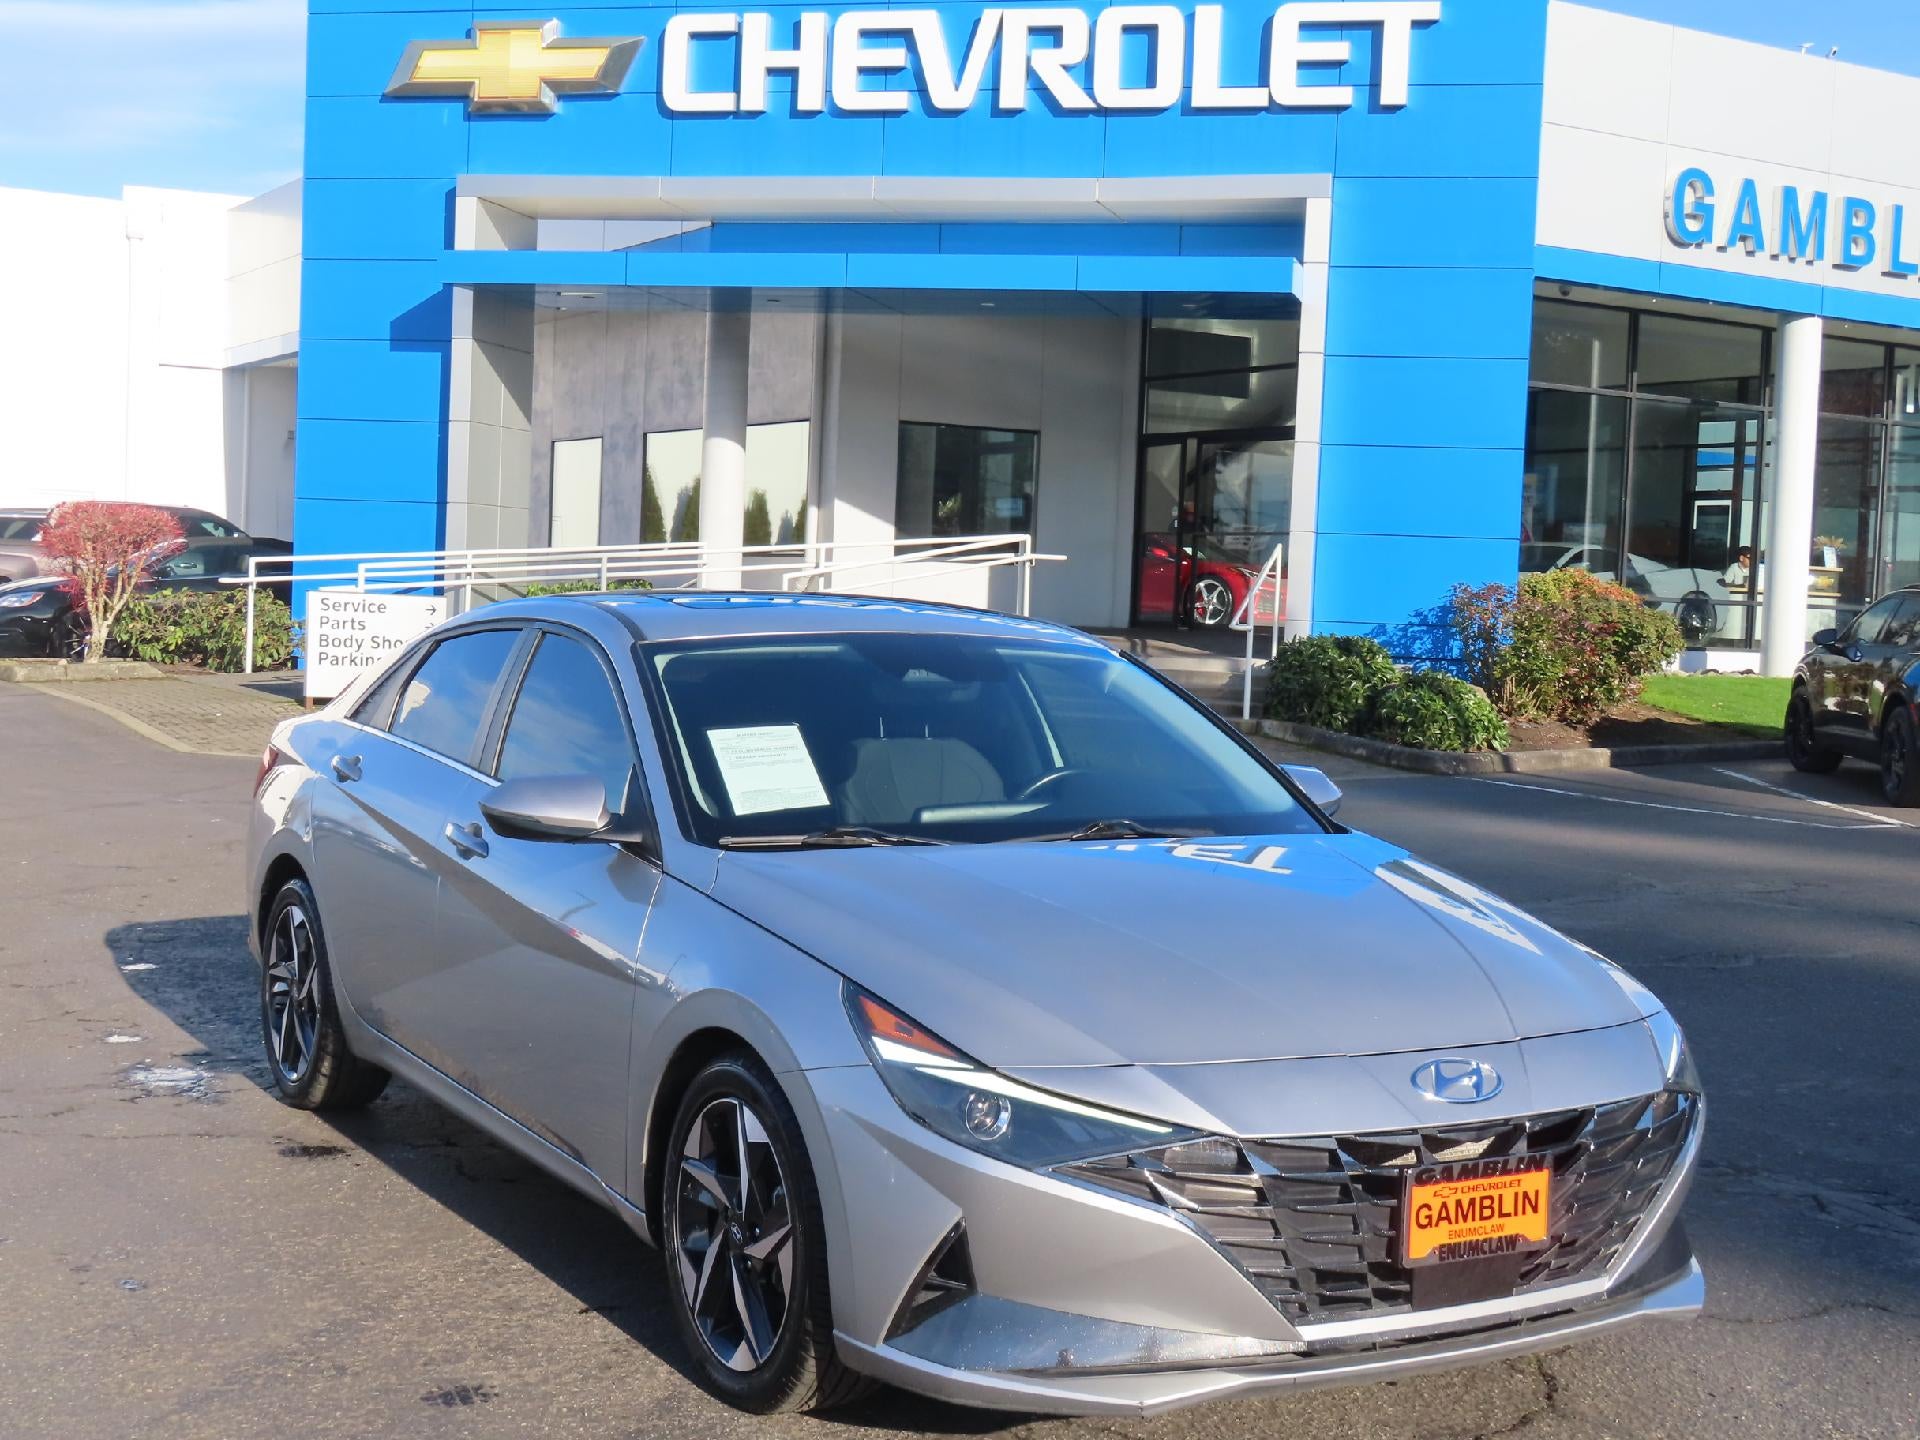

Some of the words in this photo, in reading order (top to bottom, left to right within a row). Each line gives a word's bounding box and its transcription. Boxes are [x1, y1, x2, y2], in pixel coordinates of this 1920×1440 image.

[662, 1, 1441, 113] CHEVROLET
[1665, 168, 1920, 279] GAMBL
[320, 597, 387, 614] Service
[319, 616, 366, 631] Parts
[319, 634, 364, 653] Body
[370, 635, 408, 650] Sho
[318, 652, 383, 667] Parkin
[1460, 1178, 1522, 1194] CHEVROLET
[1415, 1189, 1540, 1230] GAMBLIN
[1448, 1223, 1505, 1240] ENUMCLAW
[1438, 1233, 1518, 1261] ENUMCLAW
